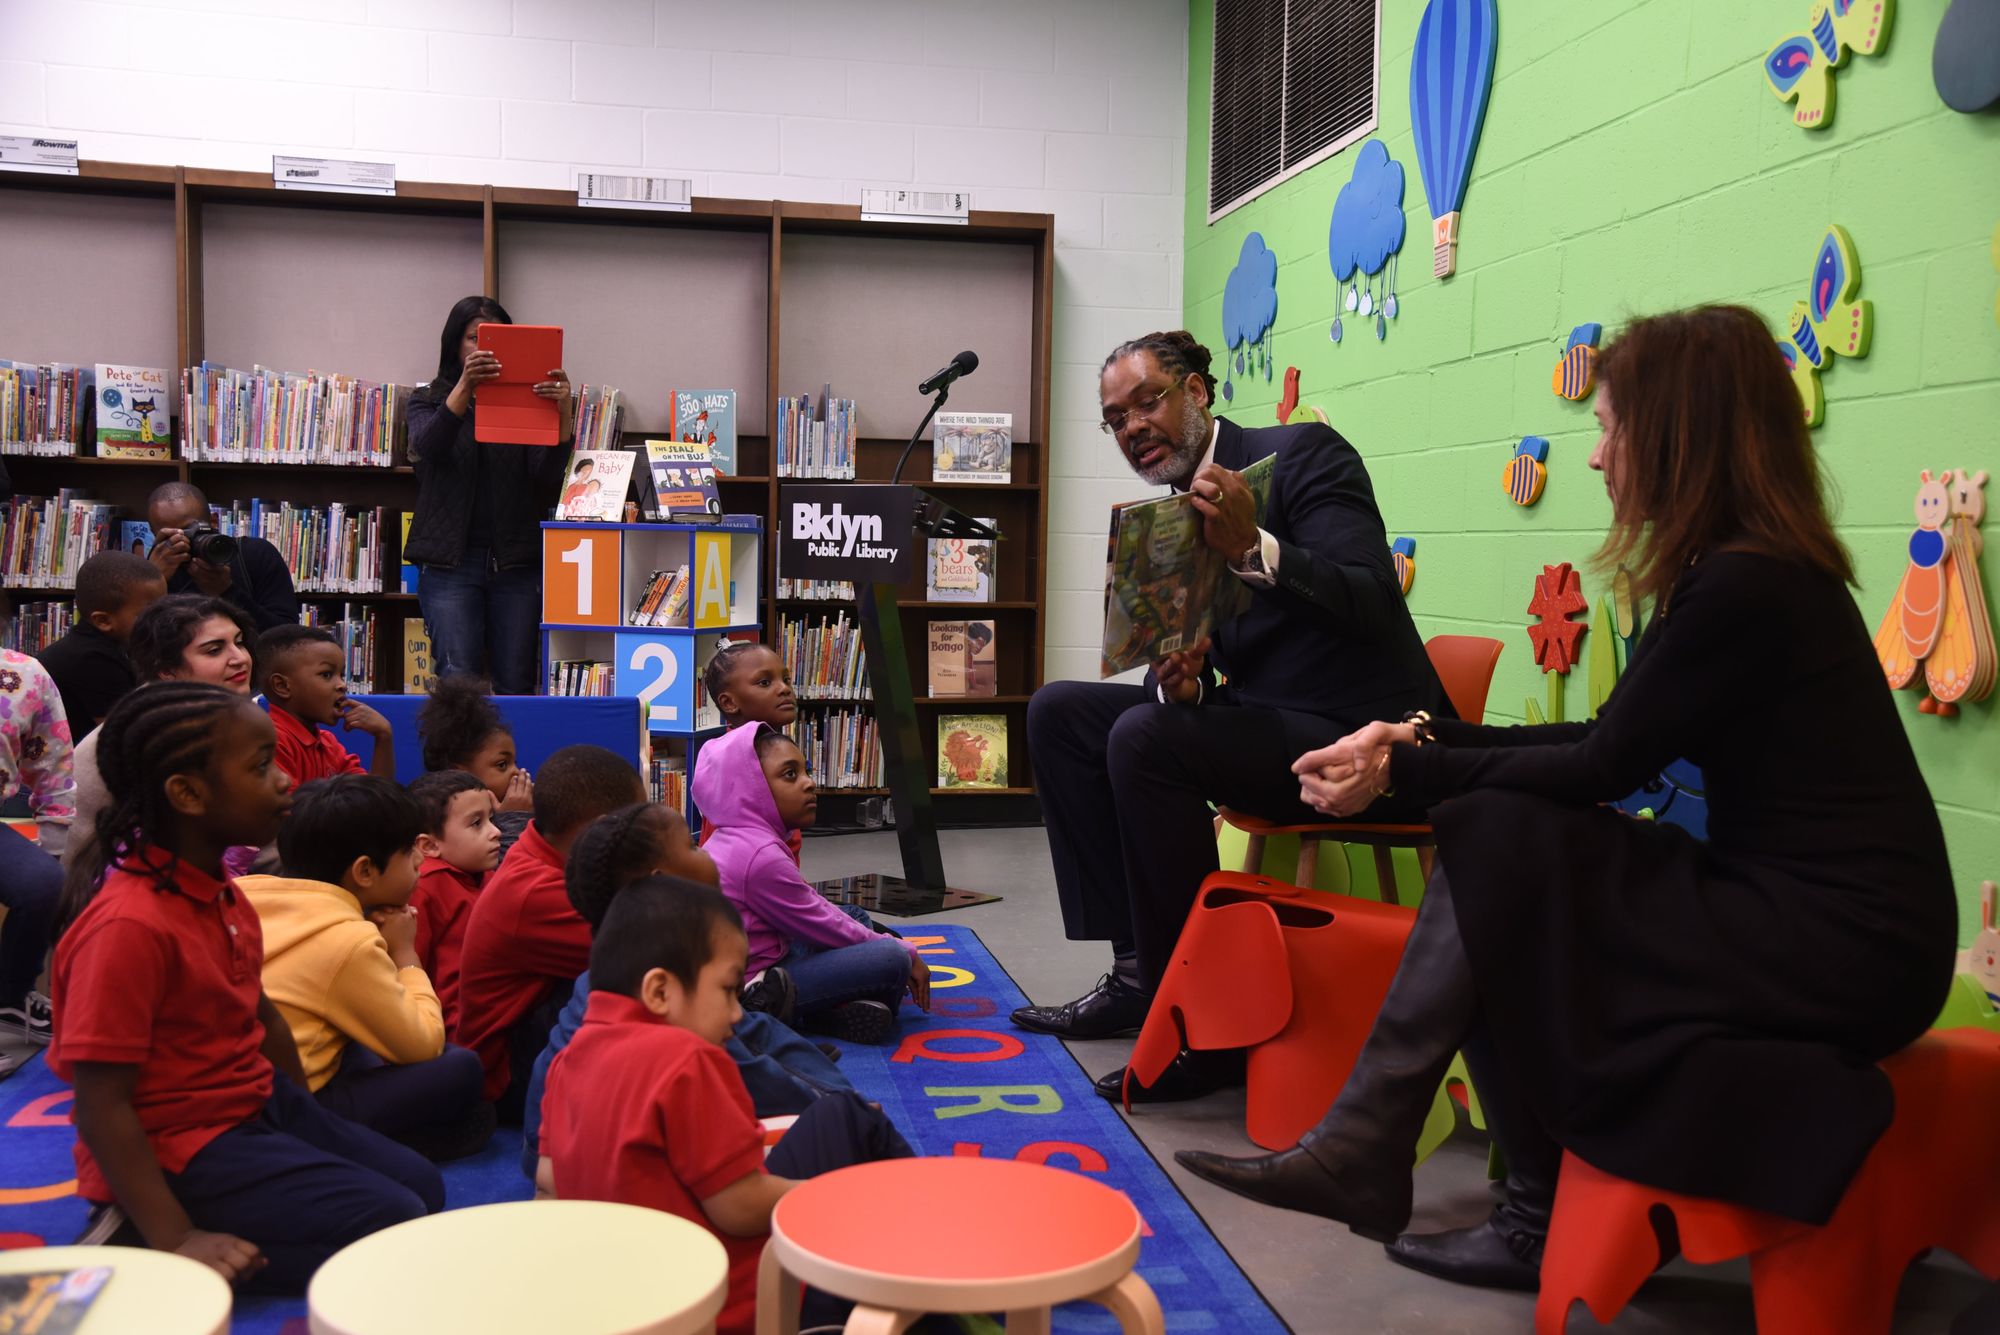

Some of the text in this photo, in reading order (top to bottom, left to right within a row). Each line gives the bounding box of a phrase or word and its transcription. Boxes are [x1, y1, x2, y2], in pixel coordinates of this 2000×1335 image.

[106, 367, 133, 381] Pete
[142, 371, 163, 383] Cat
[677, 393, 691, 403] The
[680, 394, 729, 418] 500 HATS
[939, 416, 956, 424] WHERE
[956, 416, 965, 424] THE
[978, 416, 995, 425] THINGS
[995, 417, 1005, 425] ARE
[687, 452, 705, 461] BUS
[598, 461, 625, 475] Baby
[792, 503, 882, 558] Bklyn
[808, 541, 898, 563] Public Library
[950, 538, 964, 564] 3
[940, 557, 973, 575] bears
[561, 538, 593, 616] 1
[697, 541, 727, 620] A
[930, 623, 964, 633] Looking
[940, 633, 954, 642] for
[408, 640, 427, 653] Can
[931, 641, 964, 653] Bongo
[414, 655, 427, 670] to
[629, 642, 678, 721] 2
[890, 1029, 1026, 1064] Q
[924, 1084, 1064, 1120] R
